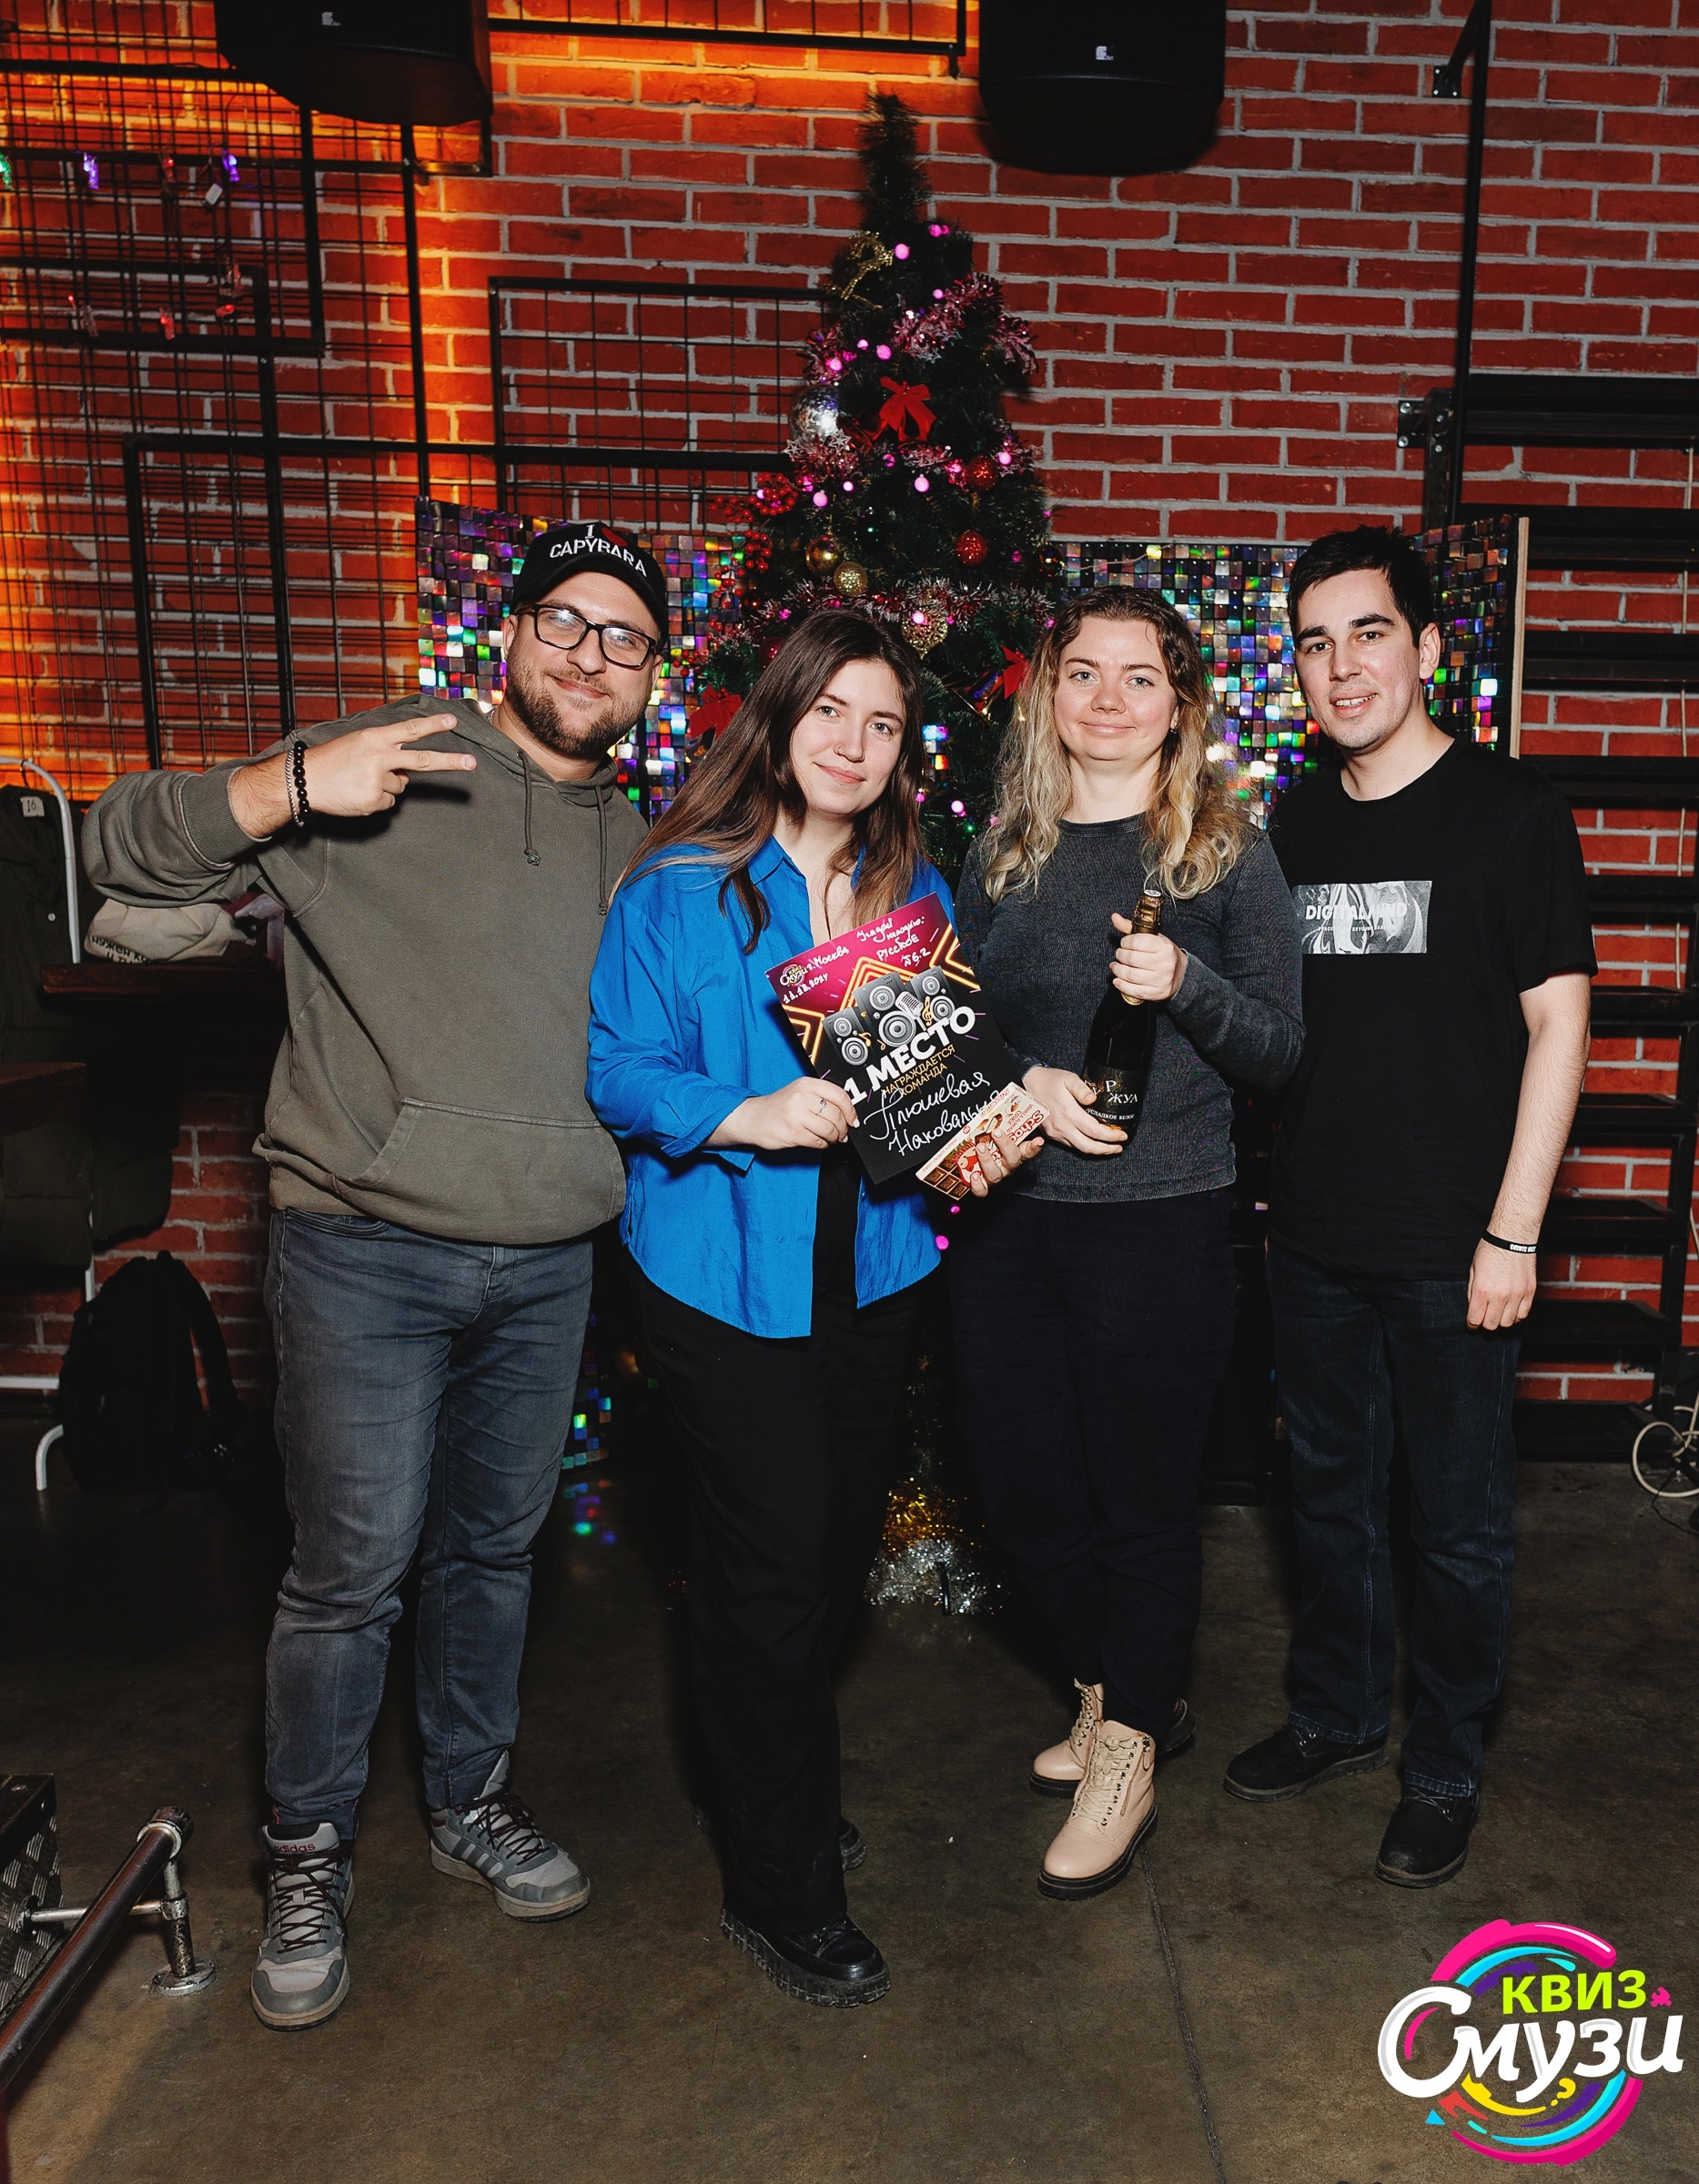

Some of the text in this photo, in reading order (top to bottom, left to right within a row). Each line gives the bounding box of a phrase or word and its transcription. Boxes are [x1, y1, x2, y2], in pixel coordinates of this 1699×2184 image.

[550, 538, 647, 577] CAPYBARA
[866, 1006, 976, 1091] МЕСТО
[881, 1044, 956, 1097] НАГРАЖДАЕТСЯ
[898, 1063, 948, 1097] КОМАНДА
[863, 1071, 990, 1141] Плюшевая
[274, 1844, 316, 1853] adidas
